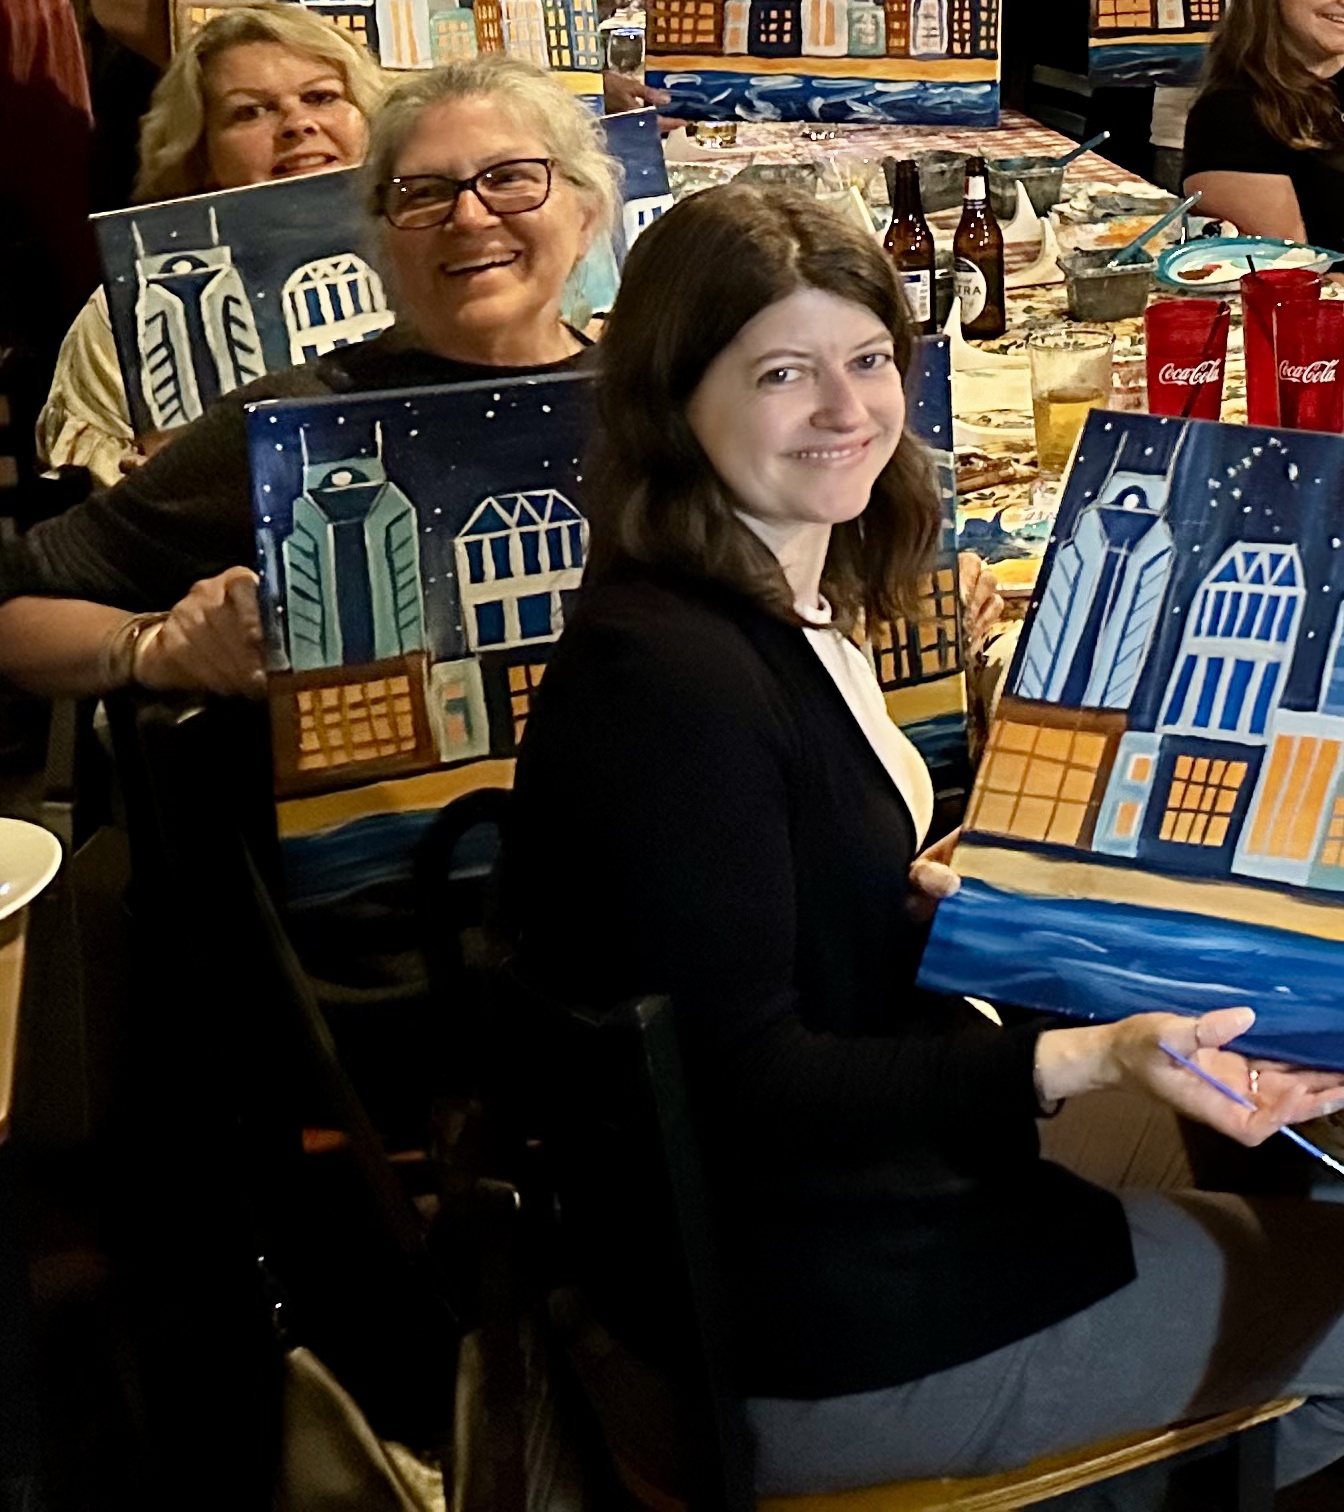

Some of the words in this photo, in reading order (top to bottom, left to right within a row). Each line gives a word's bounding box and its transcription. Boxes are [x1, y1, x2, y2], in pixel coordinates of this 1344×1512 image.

[956, 284, 982, 297] TRA
[1158, 358, 1221, 386] Coca-Cola
[1278, 358, 1339, 384] Coca-Cola
